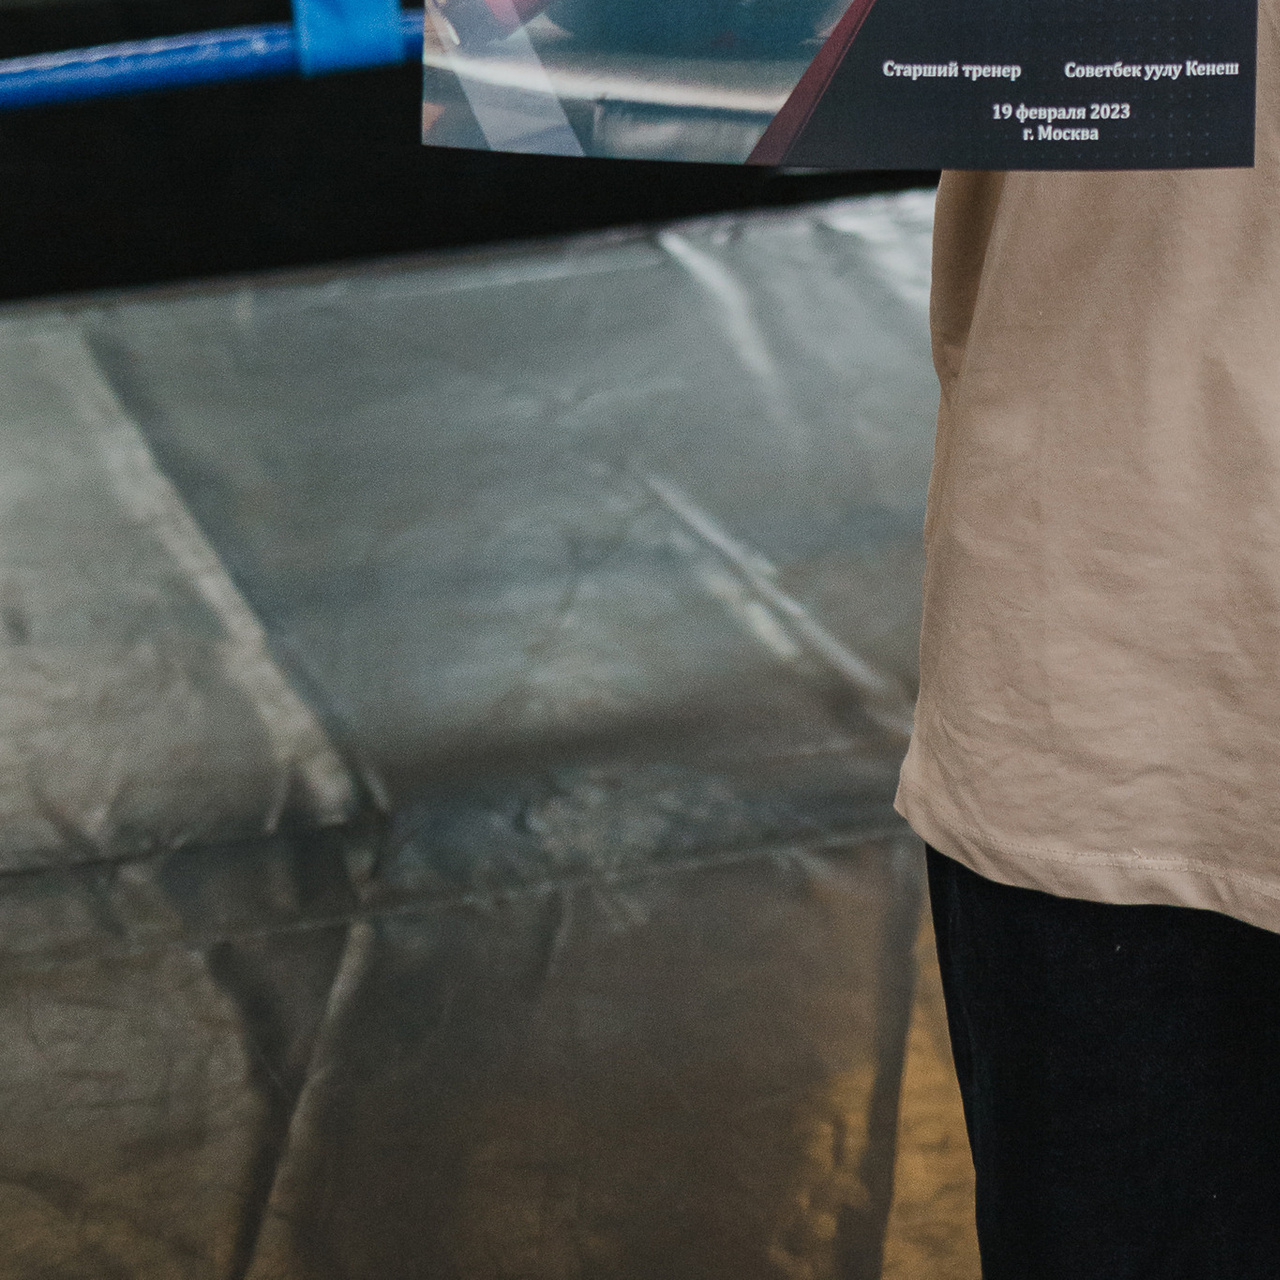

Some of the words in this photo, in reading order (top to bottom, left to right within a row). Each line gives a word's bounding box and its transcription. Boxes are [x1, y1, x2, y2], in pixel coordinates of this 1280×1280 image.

[882, 60, 959, 81] Старший
[963, 63, 1022, 82] тренер
[1064, 61, 1142, 79] Советбек
[1144, 64, 1181, 82] уулу
[1184, 60, 1240, 77] Кенеш
[992, 104, 1012, 121] 19
[1015, 104, 1087, 124] февраля
[1090, 103, 1131, 121] 2023
[1022, 127, 1034, 142] г.
[1038, 125, 1099, 142] Москва
